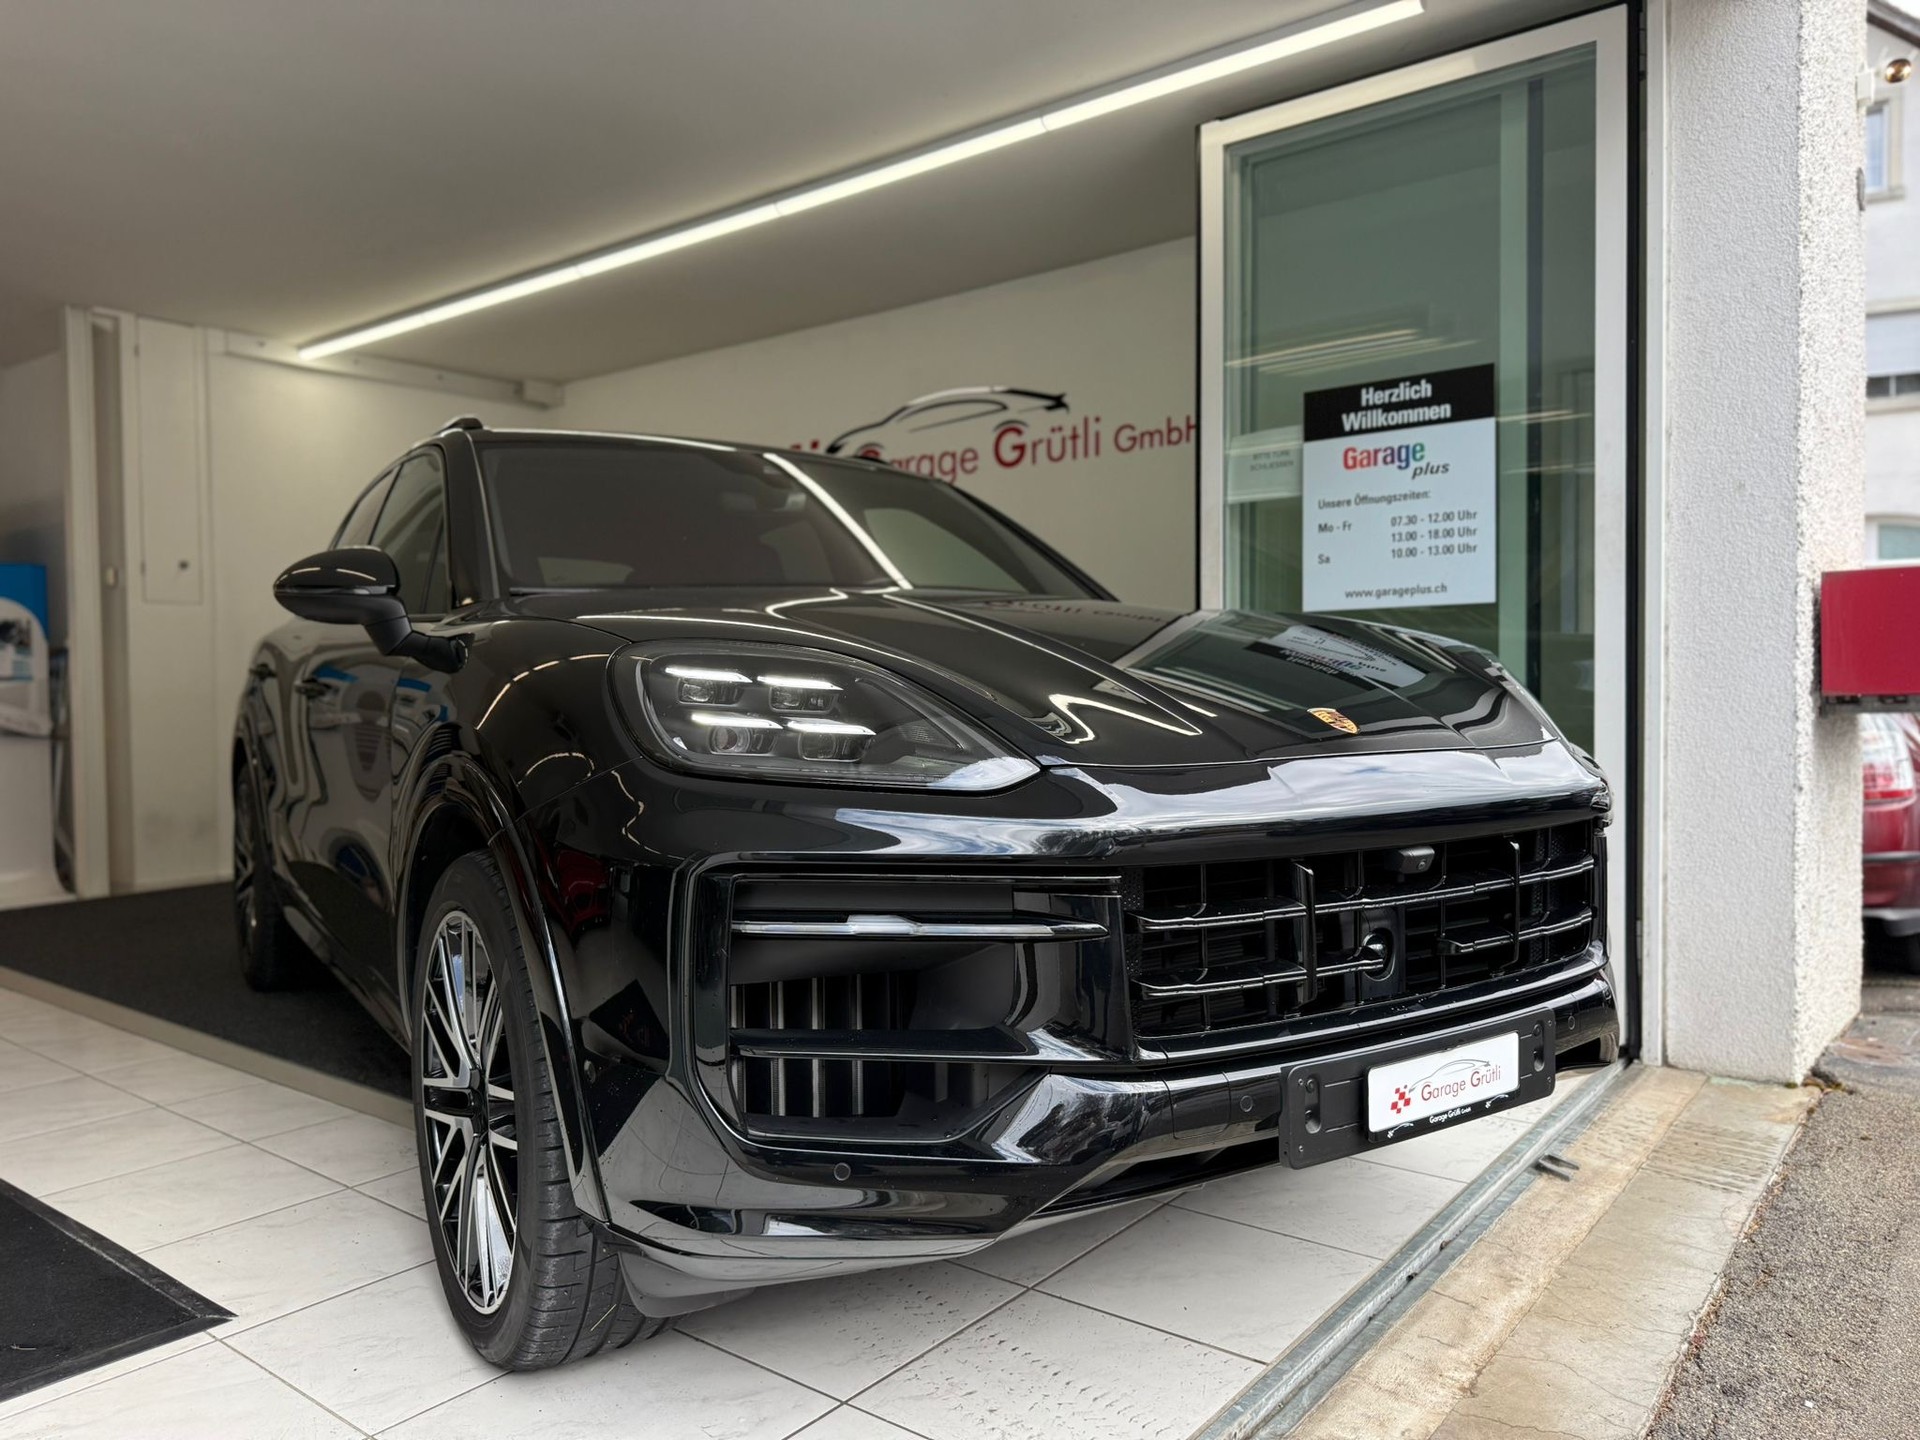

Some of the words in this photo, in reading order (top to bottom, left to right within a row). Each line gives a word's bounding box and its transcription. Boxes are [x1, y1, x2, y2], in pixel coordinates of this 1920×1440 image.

[1360, 379, 1432, 407] Herzlich
[1342, 402, 1451, 432] Willkommen
[994, 416, 1102, 469] Grütli
[1343, 442, 1425, 471] Garage
[1411, 462, 1450, 480] plus
[1318, 498, 1352, 510] Unsere
[1354, 490, 1431, 507] Öffnungszeiten:
[1318, 523, 1334, 533] Mo
[1342, 521, 1352, 532] Fr
[1391, 514, 1418, 527] 07.30
[1428, 512, 1454, 524] 12.00
[1457, 510, 1478, 521] Uhr
[1391, 531, 1418, 543] 13.00
[1428, 529, 1454, 540] 18.00
[1457, 527, 1478, 538] Uhr
[1318, 554, 1330, 565] Sa
[1391, 547, 1418, 559] 10.00
[1428, 544, 1454, 556] 13.00
[1457, 543, 1478, 554] Uhr
[1345, 583, 1448, 599] www.garageplus.ch
[1421, 1080, 1466, 1101] Garage
[1470, 1065, 1501, 1088] Grütli
[1429, 1113, 1447, 1124] Garage
